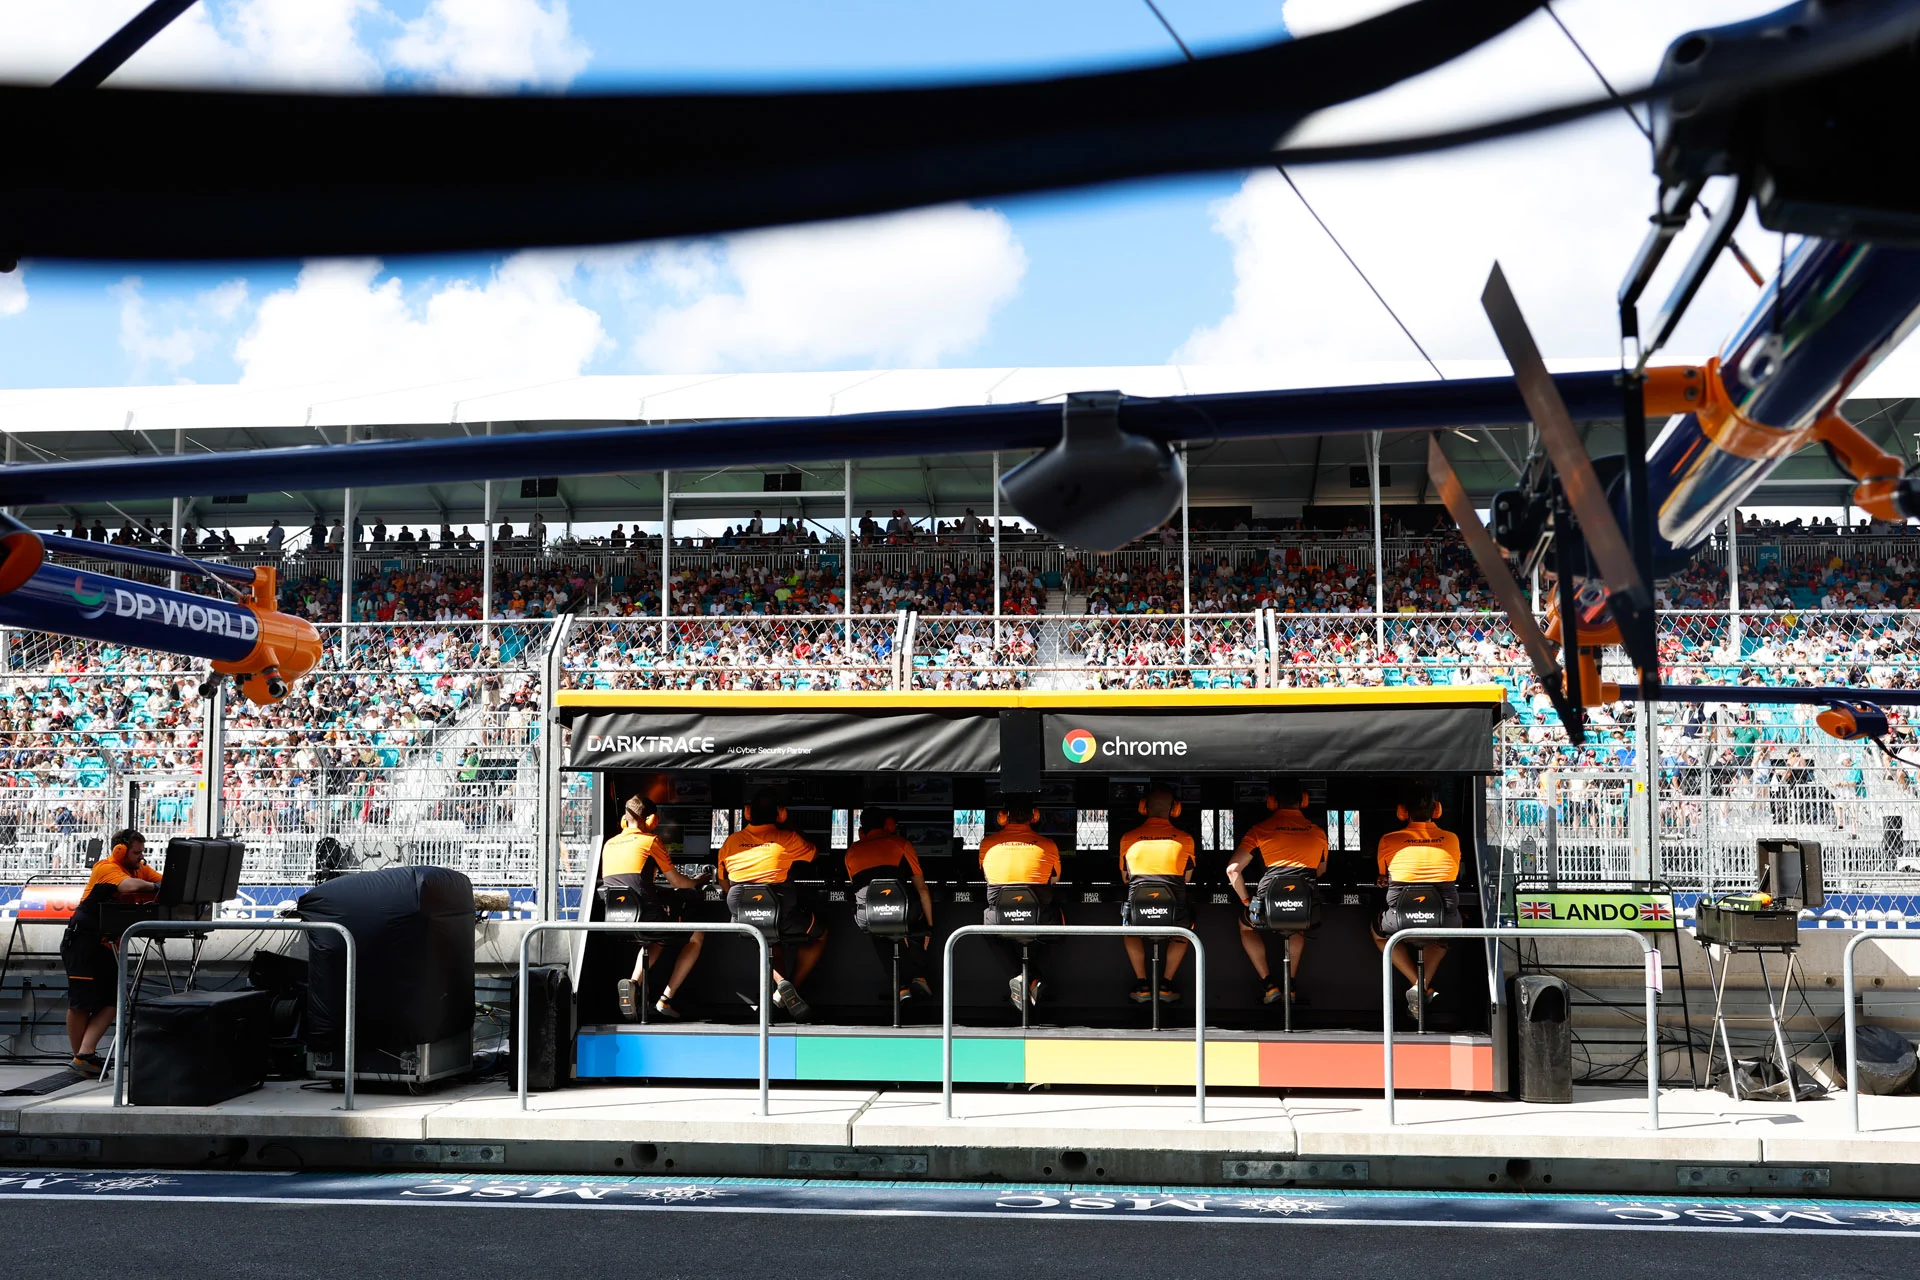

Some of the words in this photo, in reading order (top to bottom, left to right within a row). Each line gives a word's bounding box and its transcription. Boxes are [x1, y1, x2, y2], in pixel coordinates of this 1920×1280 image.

[114, 588, 156, 620] DP
[158, 598, 259, 641] WORLD
[587, 735, 715, 753] DARKTRACE
[1102, 736, 1188, 756] chrome
[735, 746, 757, 755] Cyber
[757, 746, 785, 756] Security
[786, 747, 812, 755] Partner
[873, 903, 900, 912] webex
[1274, 899, 1303, 908] webex
[610, 910, 633, 918] webex
[744, 908, 772, 917] webex
[1003, 909, 1032, 918] webex
[1139, 906, 1168, 915] webex
[1405, 910, 1435, 919] webex
[1551, 903, 1639, 921] LANDO
[400, 1184, 621, 1200] MSC
[995, 1196, 1215, 1212] MSC
[1607, 1207, 1855, 1225] MSC
